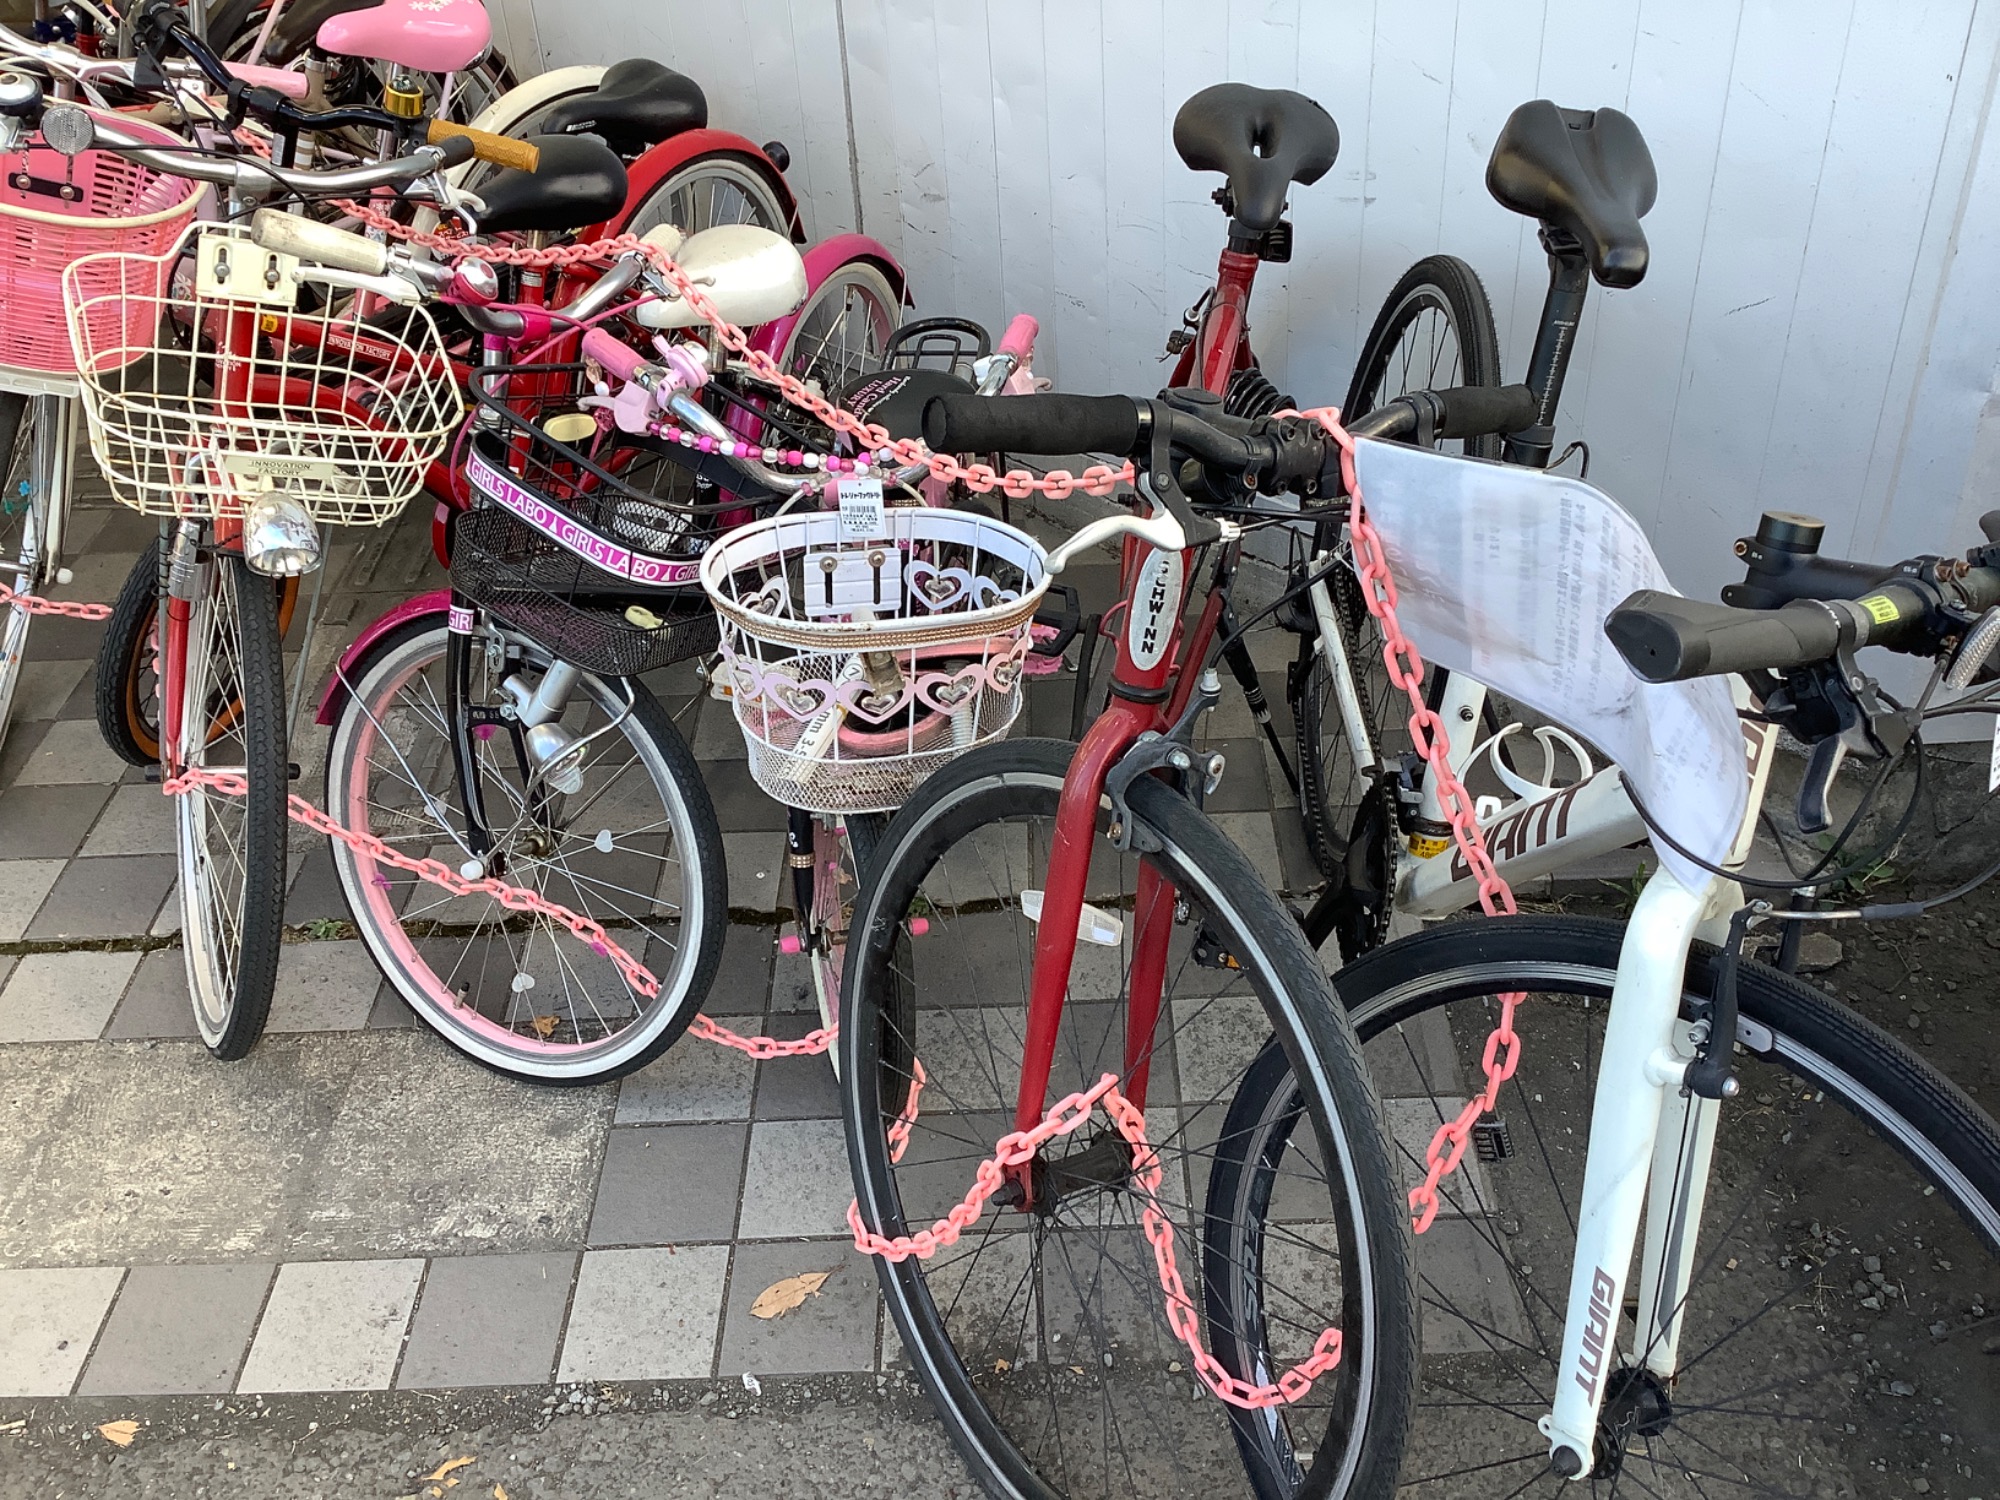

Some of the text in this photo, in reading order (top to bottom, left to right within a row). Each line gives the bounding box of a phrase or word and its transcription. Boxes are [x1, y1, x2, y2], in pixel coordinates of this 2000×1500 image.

[853, 393, 878, 419] Cand
[250, 460, 311, 476] INNOVATION FACTORY
[471, 462, 505, 499] GIRLS
[506, 487, 547, 527] LABO
[561, 524, 607, 562] GIRLS
[606, 552, 660, 580] LABO
[1575, 1265, 1616, 1408] GIANT
